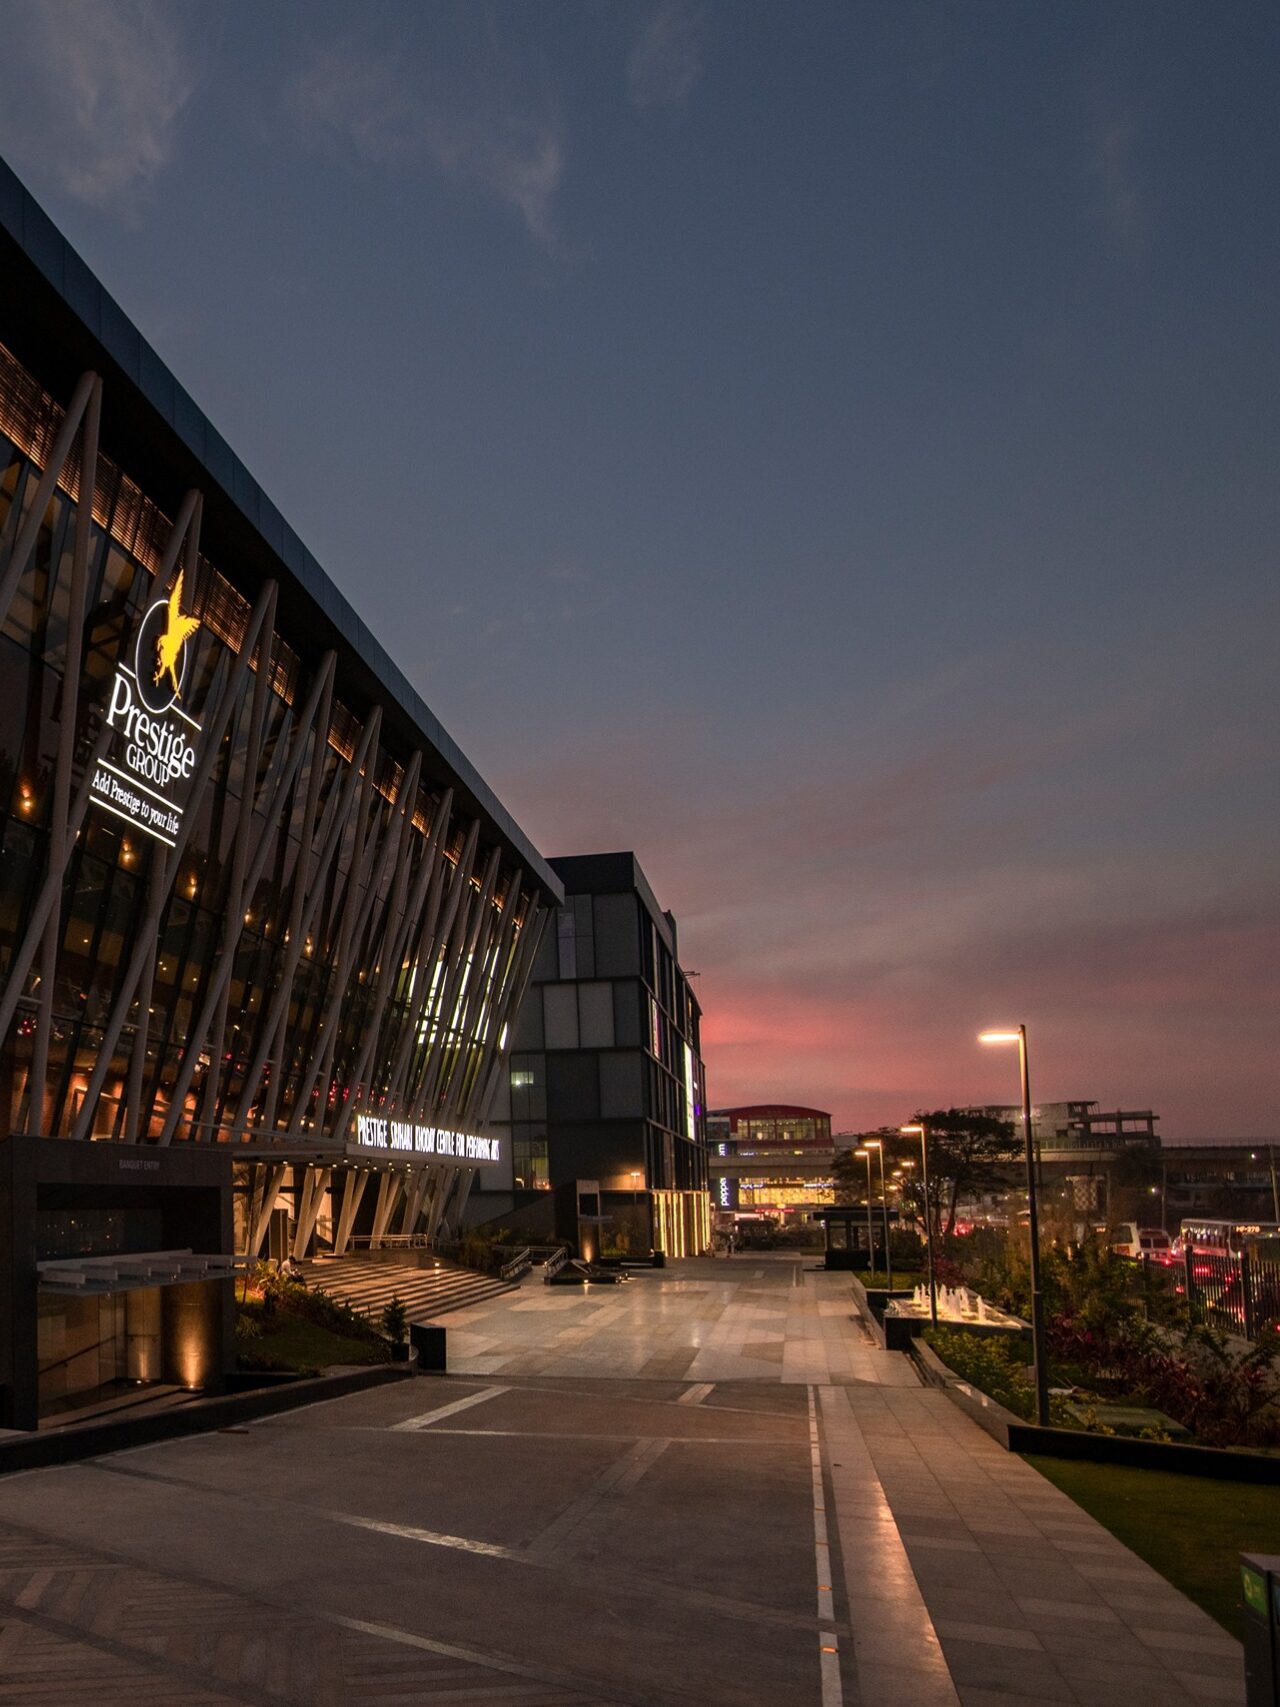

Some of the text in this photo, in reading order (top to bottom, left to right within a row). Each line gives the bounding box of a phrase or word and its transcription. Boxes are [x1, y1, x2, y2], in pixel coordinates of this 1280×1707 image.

[106, 672, 195, 779] Prestige
[126, 743, 169, 787] GROUP
[92, 769, 179, 835] Add Prestige to your life
[357, 1114, 388, 1148] PRESTIGE
[437, 1129, 455, 1156] CENTRE
[456, 1132, 465, 1157] FOR
